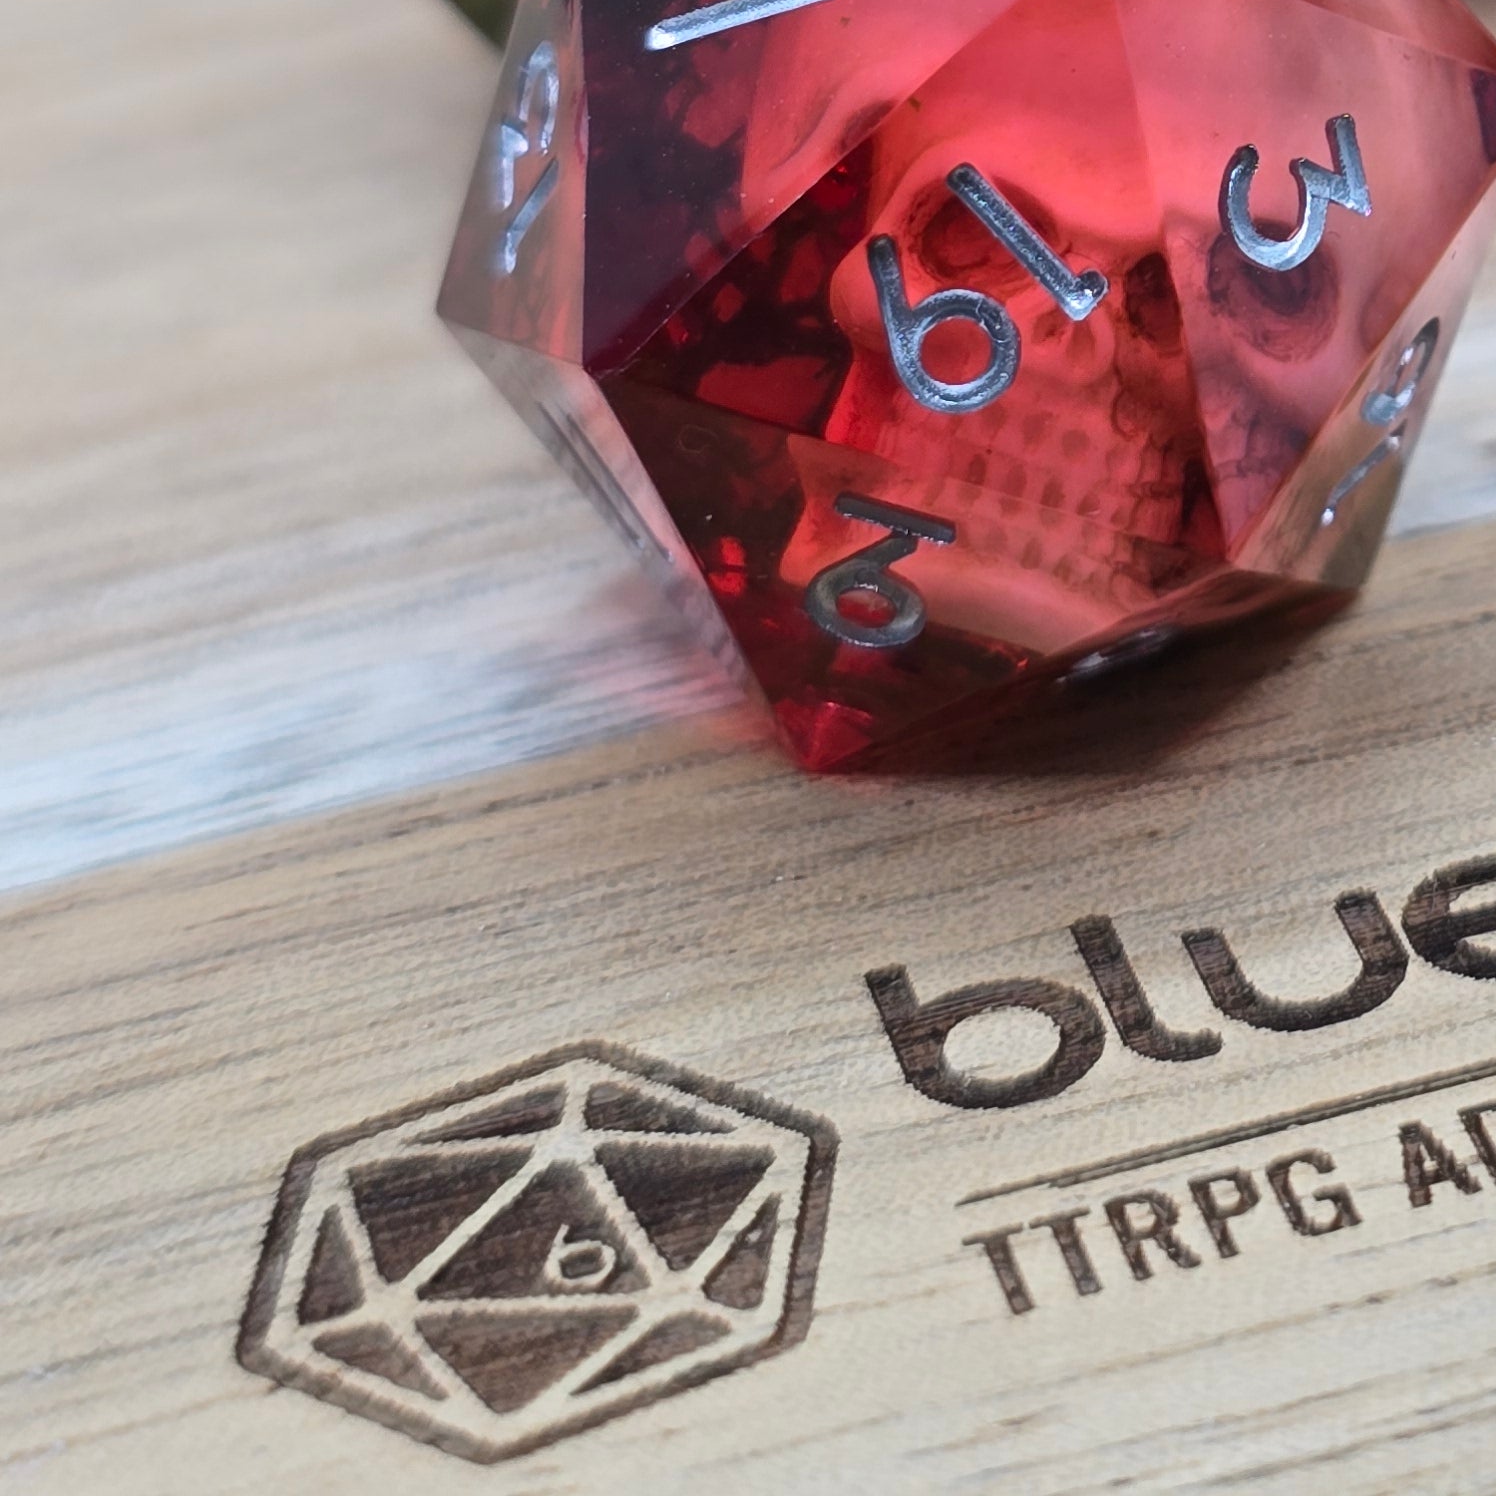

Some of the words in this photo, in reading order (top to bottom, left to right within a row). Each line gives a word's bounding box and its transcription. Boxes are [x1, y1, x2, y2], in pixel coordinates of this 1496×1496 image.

[1218, 112, 1374, 272] 3
[866, 162, 1108, 412] 19
[962, 1148, 1362, 1316] TTRPG
